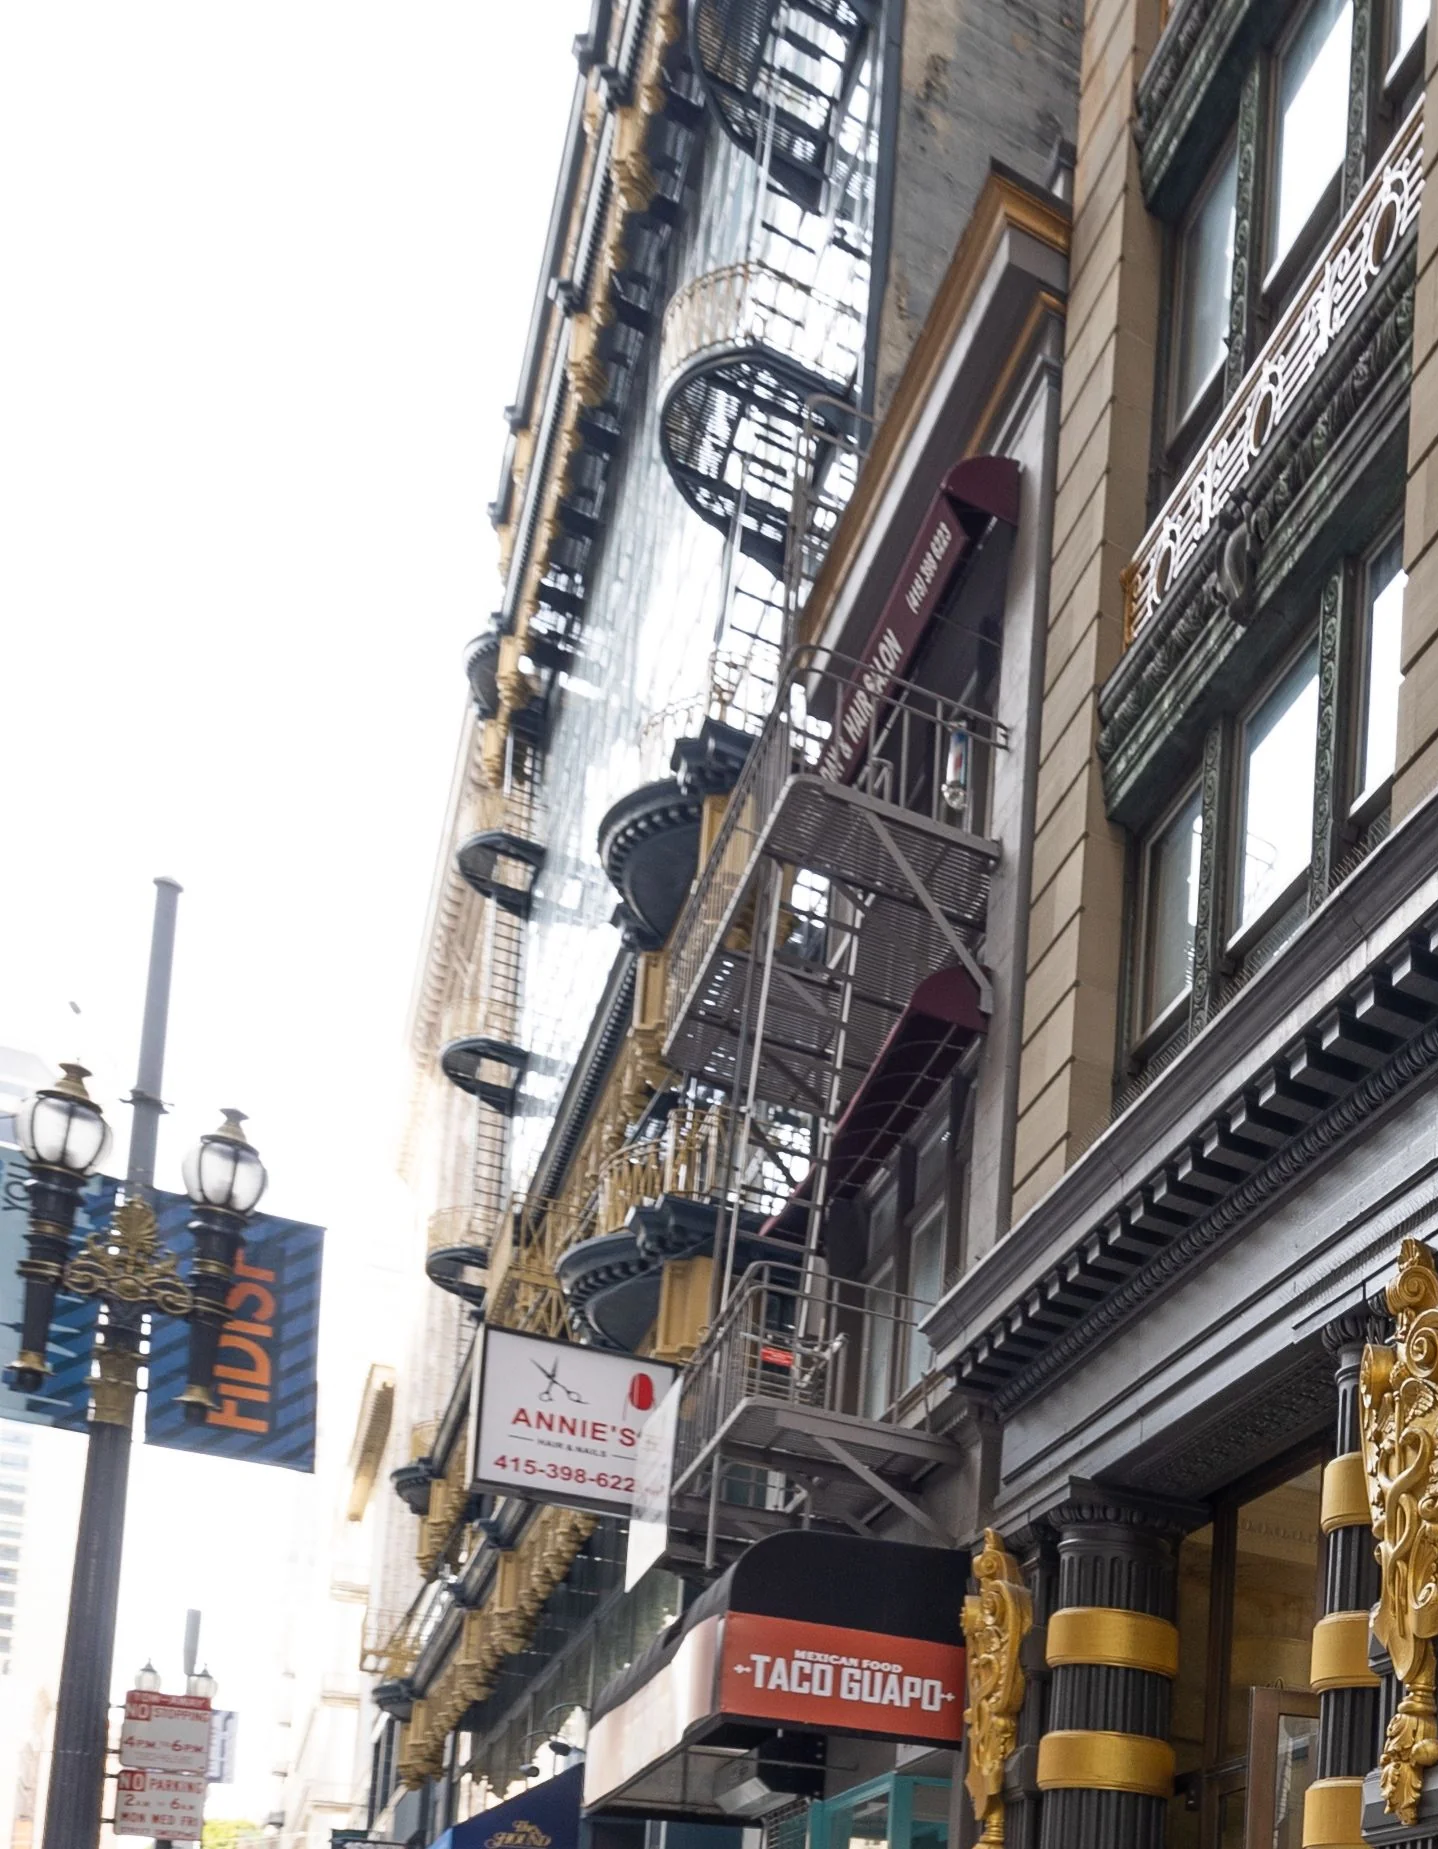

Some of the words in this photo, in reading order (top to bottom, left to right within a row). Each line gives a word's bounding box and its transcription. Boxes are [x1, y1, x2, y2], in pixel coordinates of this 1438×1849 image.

[843, 690, 874, 744] HAIR
[511, 1407, 637, 1447] ANNIE'S
[537, 1437, 563, 1449] HAIR
[575, 1446, 607, 1458] NAILS
[493, 1454, 664, 1496] 415-398-622
[794, 1649, 859, 1668] MEXICAN
[861, 1658, 903, 1674] FOOD
[750, 1653, 833, 1697] TACO
[839, 1666, 942, 1712] GUAPO
